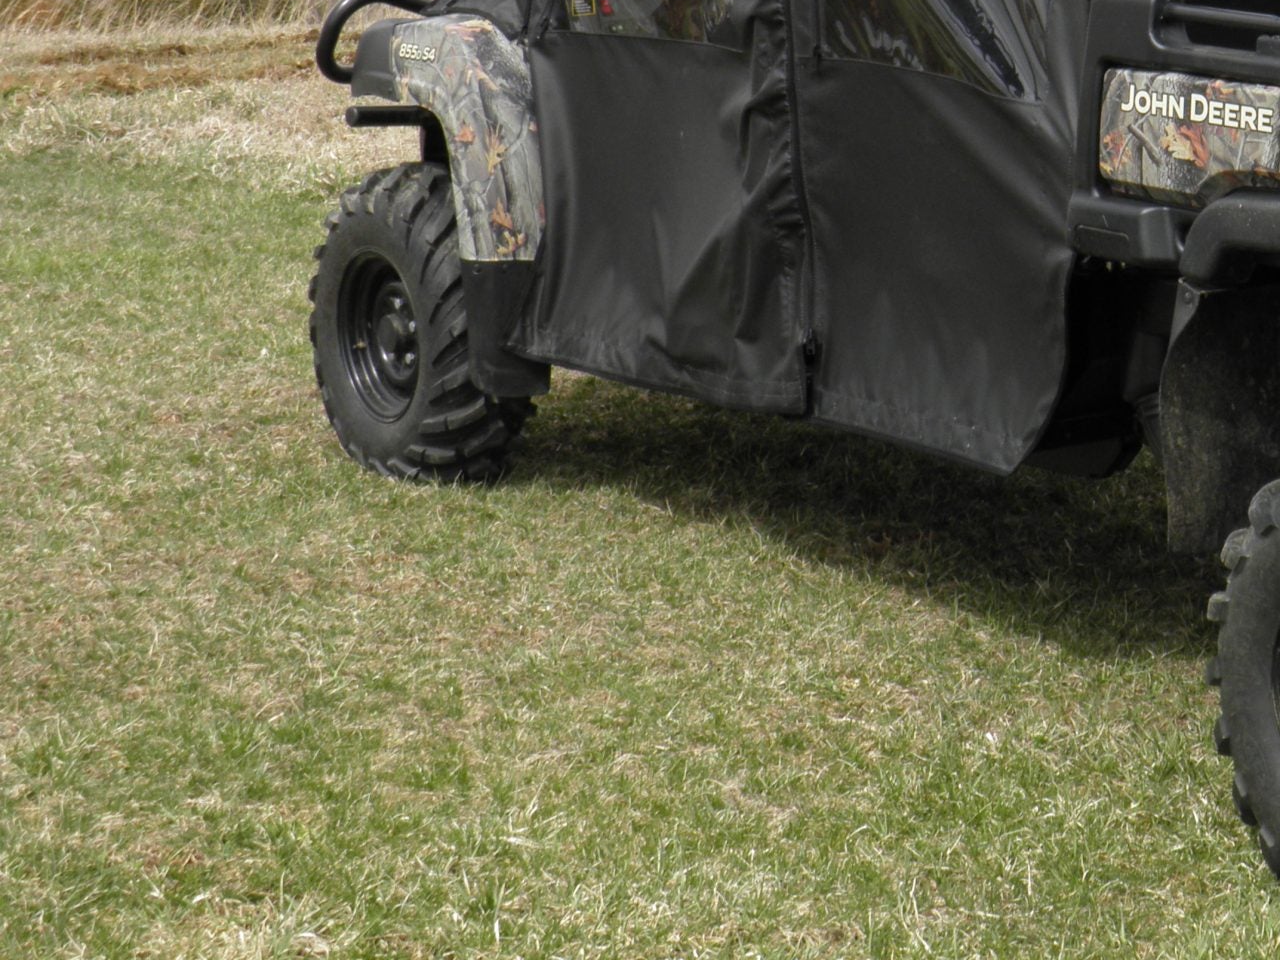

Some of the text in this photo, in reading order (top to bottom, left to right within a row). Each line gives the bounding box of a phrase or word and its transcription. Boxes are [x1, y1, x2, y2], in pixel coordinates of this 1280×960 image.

[422, 46, 436, 62] S4
[1120, 84, 1274, 133] JOHN DEERE
